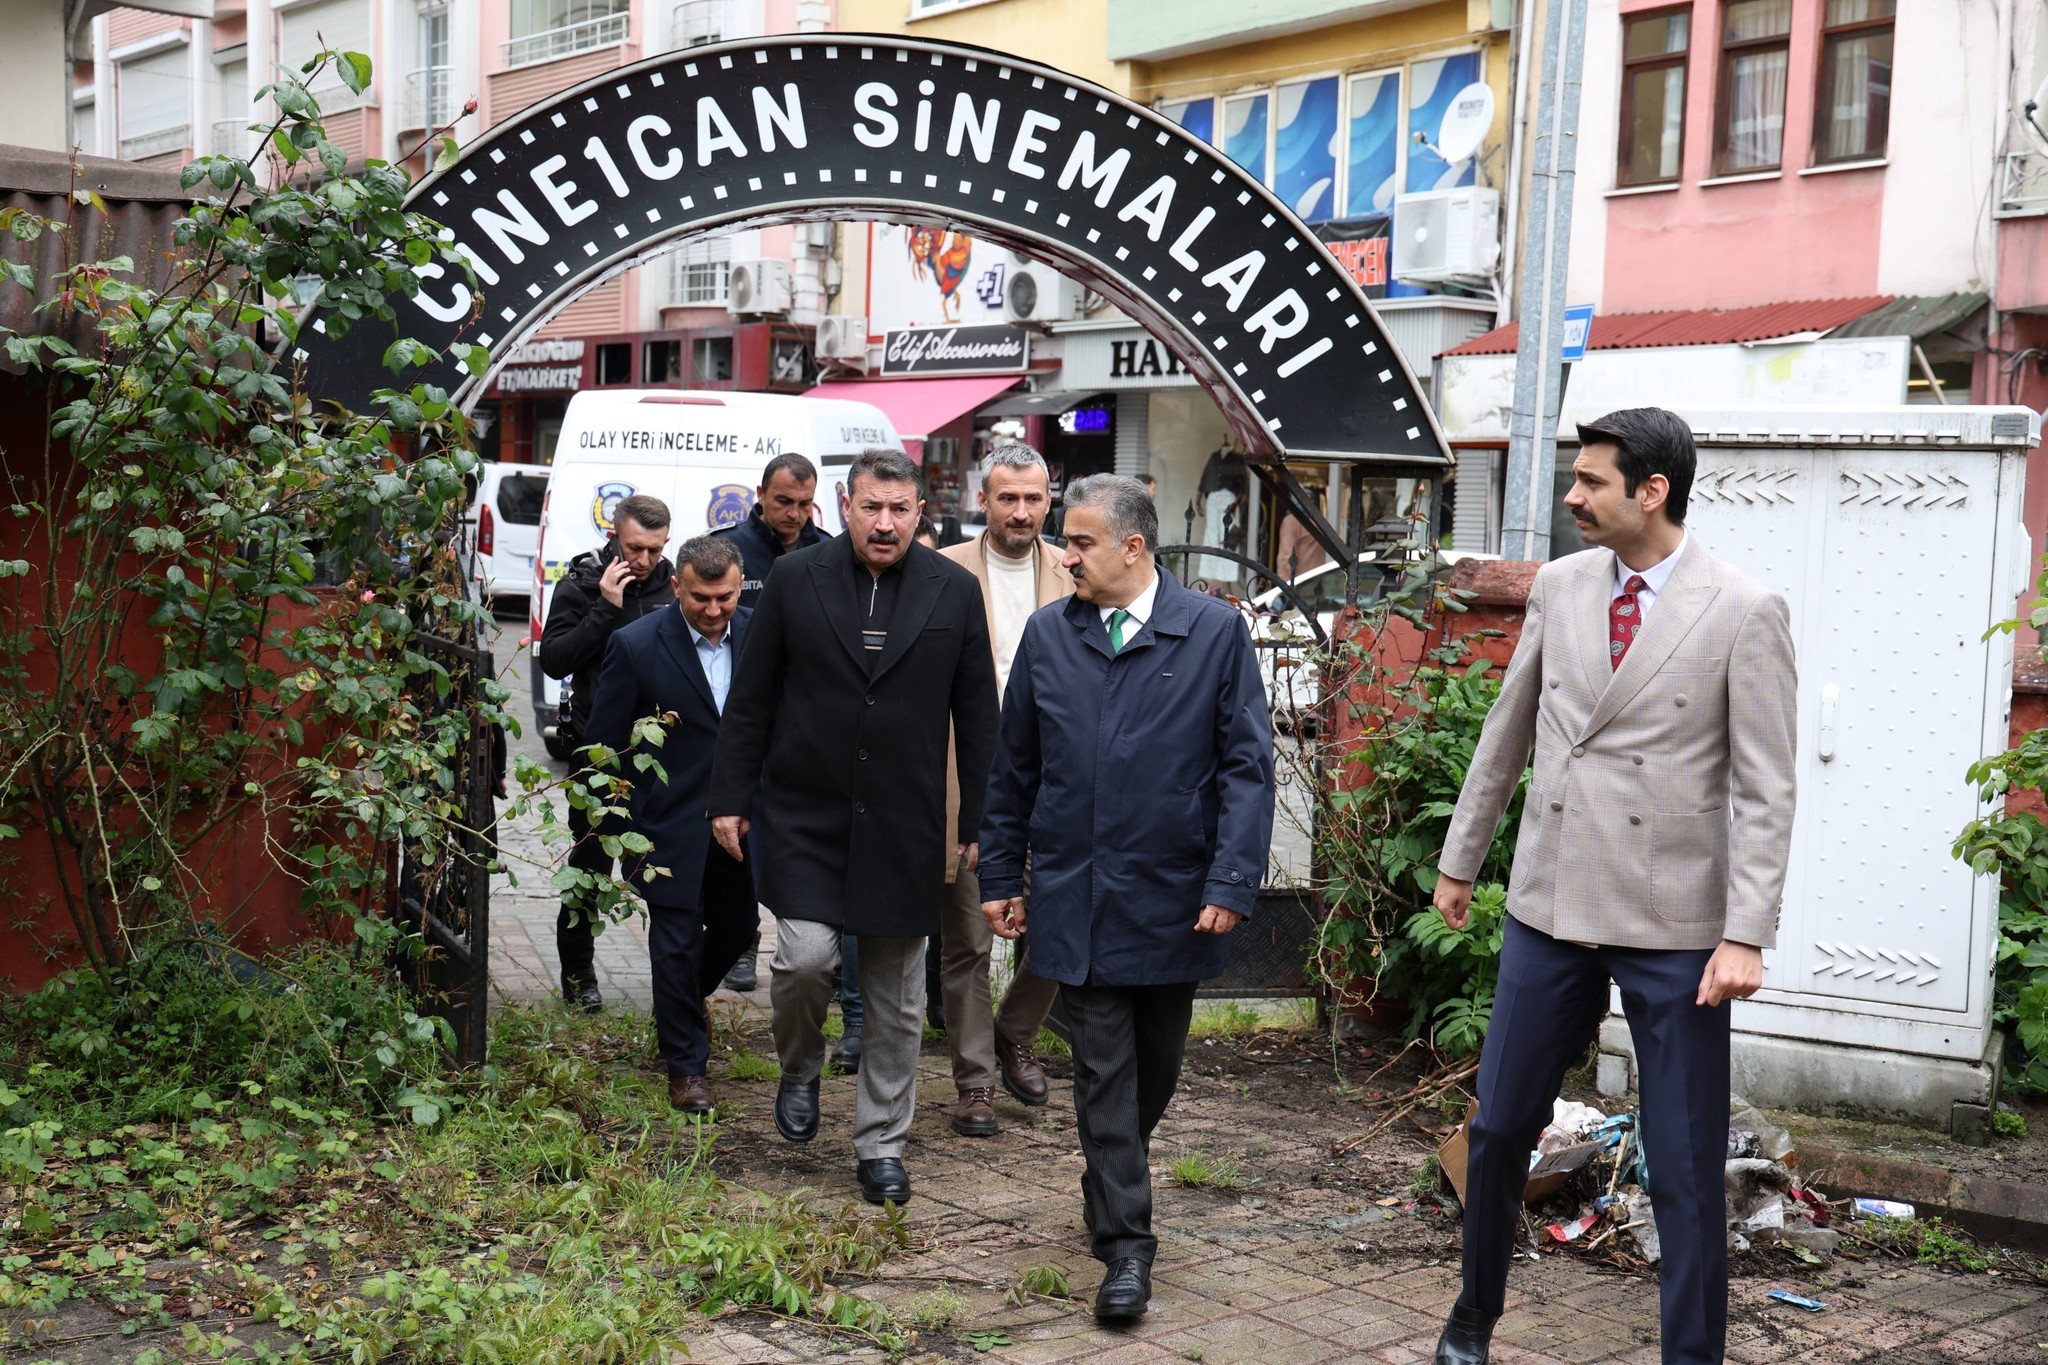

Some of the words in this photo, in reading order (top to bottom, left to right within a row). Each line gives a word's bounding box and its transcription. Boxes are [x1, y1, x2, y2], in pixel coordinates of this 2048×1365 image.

[887, 330, 934, 371] Elif
[925, 328, 1022, 360] Accessories
[1110, 339, 1192, 377] HAY
[516, 368, 579, 391] MARKET
[579, 431, 617, 449] OLAY
